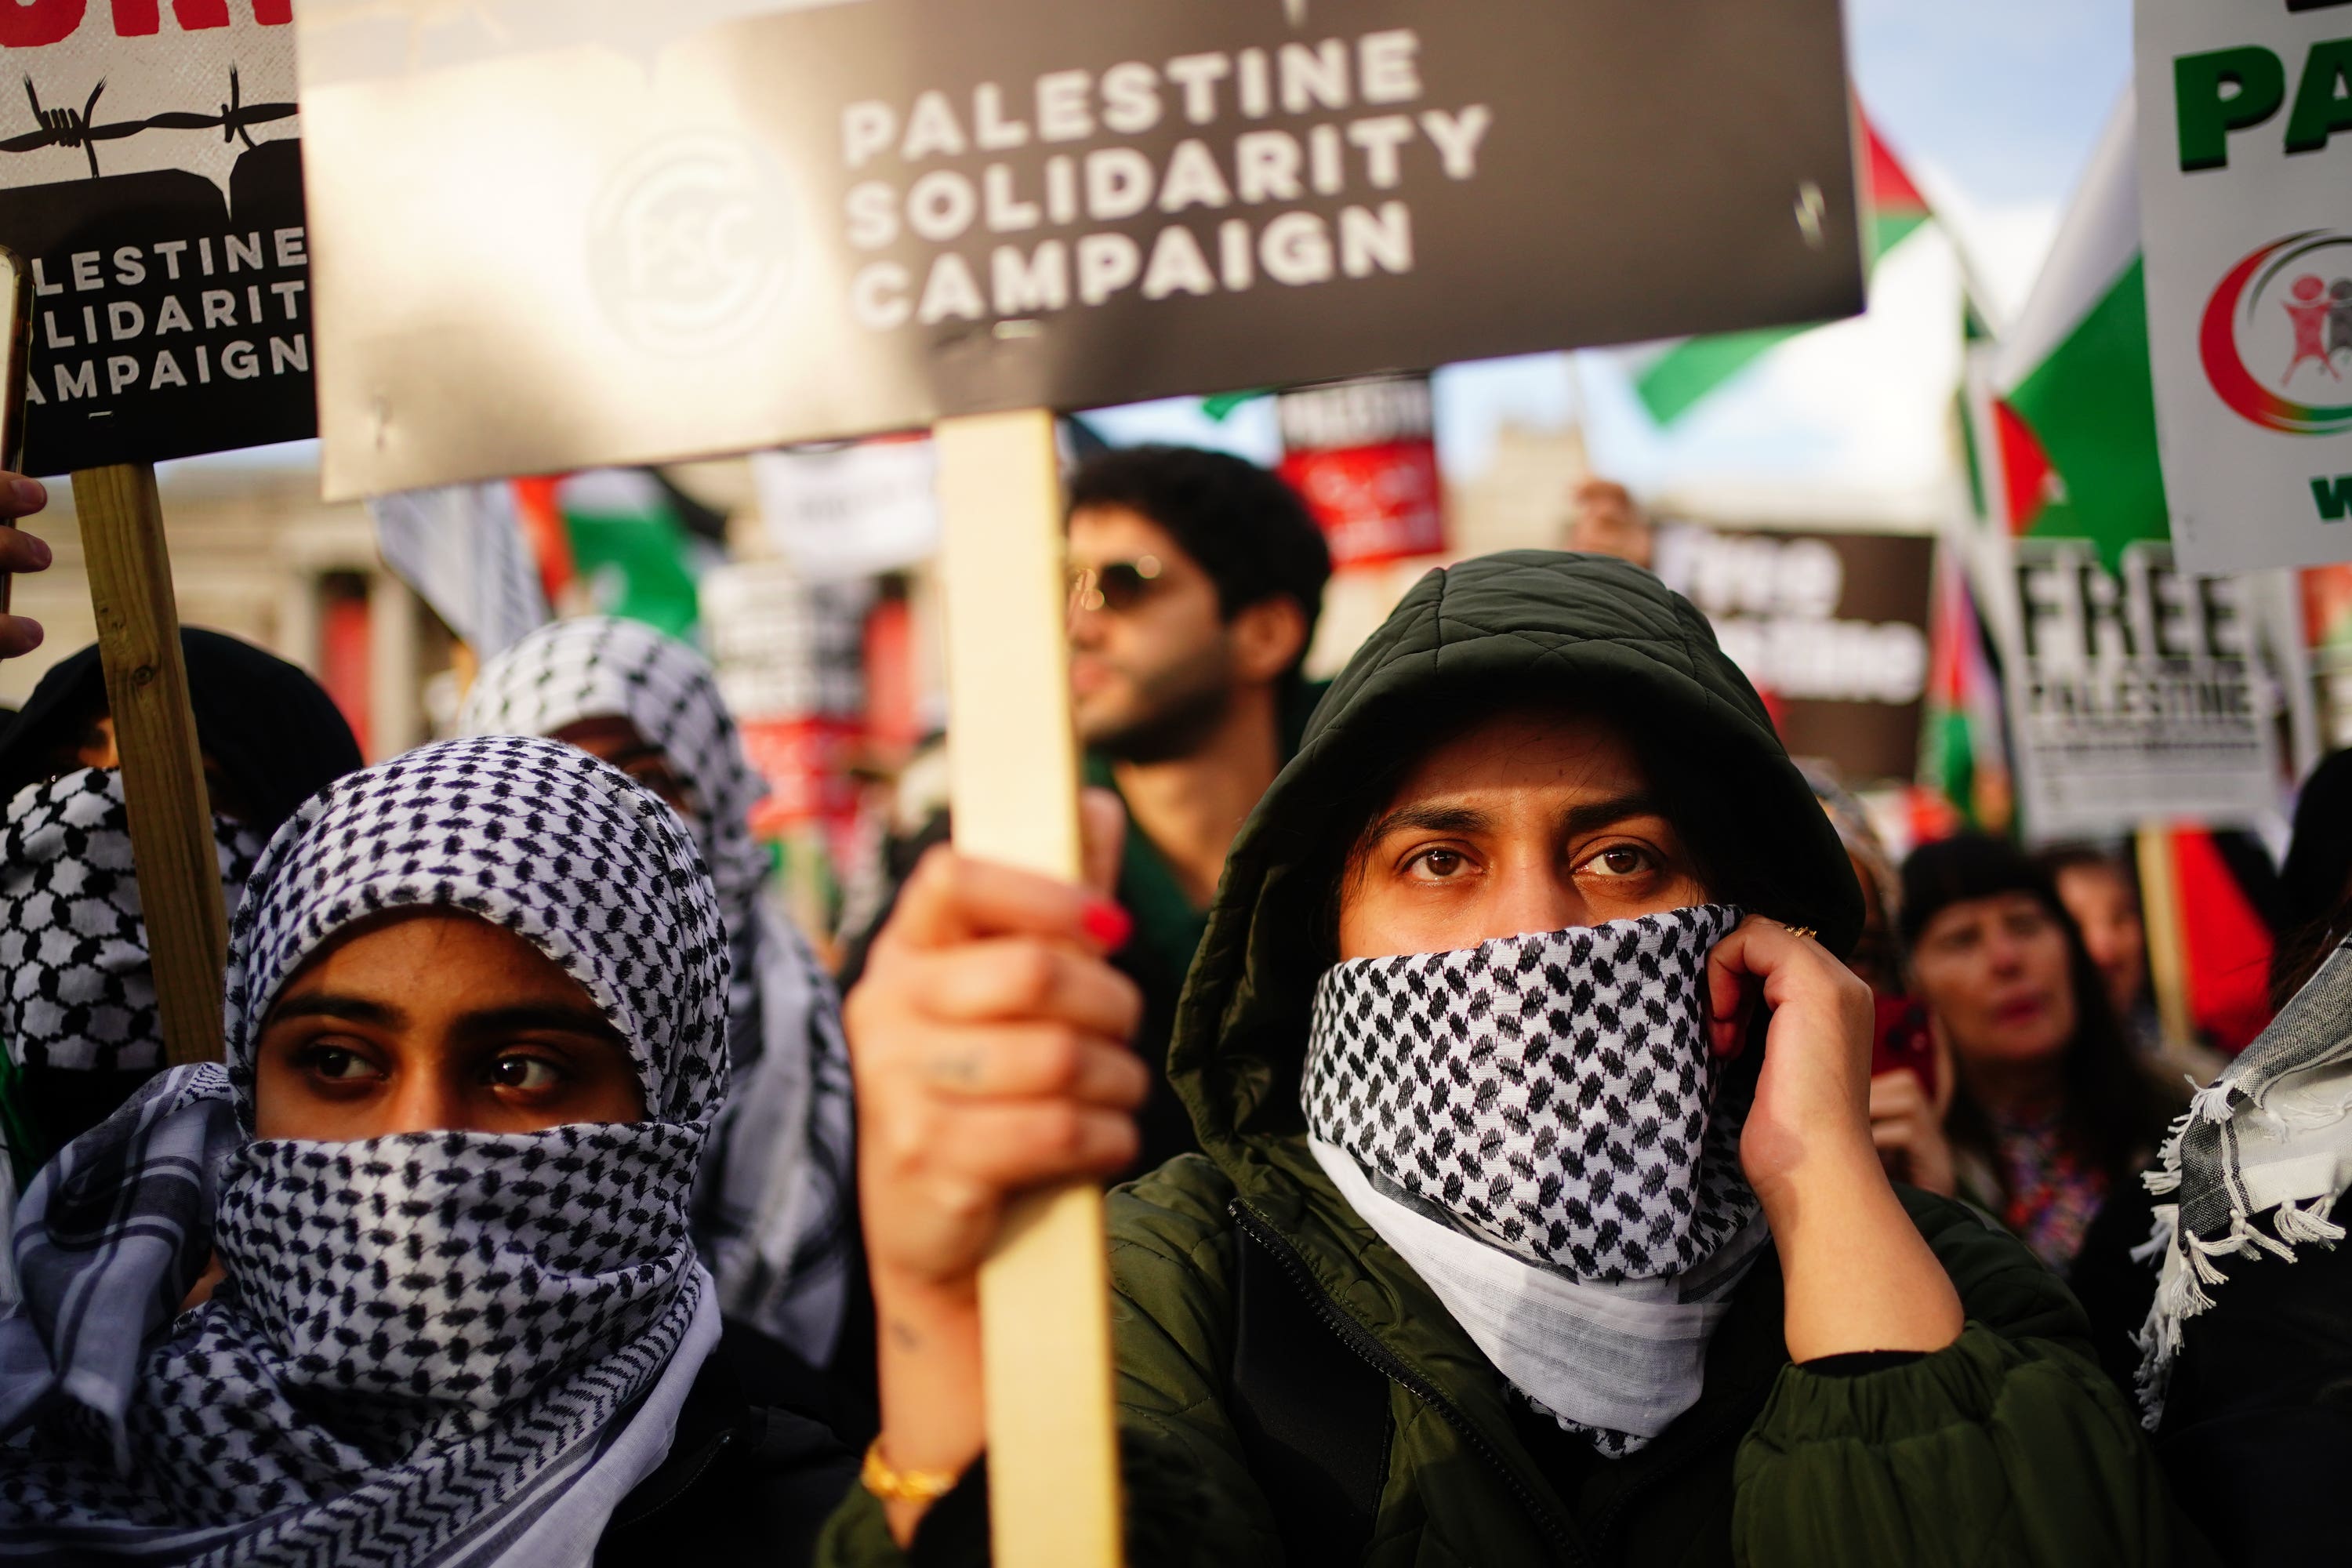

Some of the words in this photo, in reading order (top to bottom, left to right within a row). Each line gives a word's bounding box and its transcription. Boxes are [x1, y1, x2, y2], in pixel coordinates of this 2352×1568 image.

[841, 28, 1421, 169] PALESTINE
[844, 103, 1490, 250] SOLIDARITY
[31, 227, 308, 296] LESTINE
[849, 201, 1414, 329] CAMPAIGN
[44, 280, 306, 349] LIDARIT
[26, 334, 309, 405] AMPAIGN
